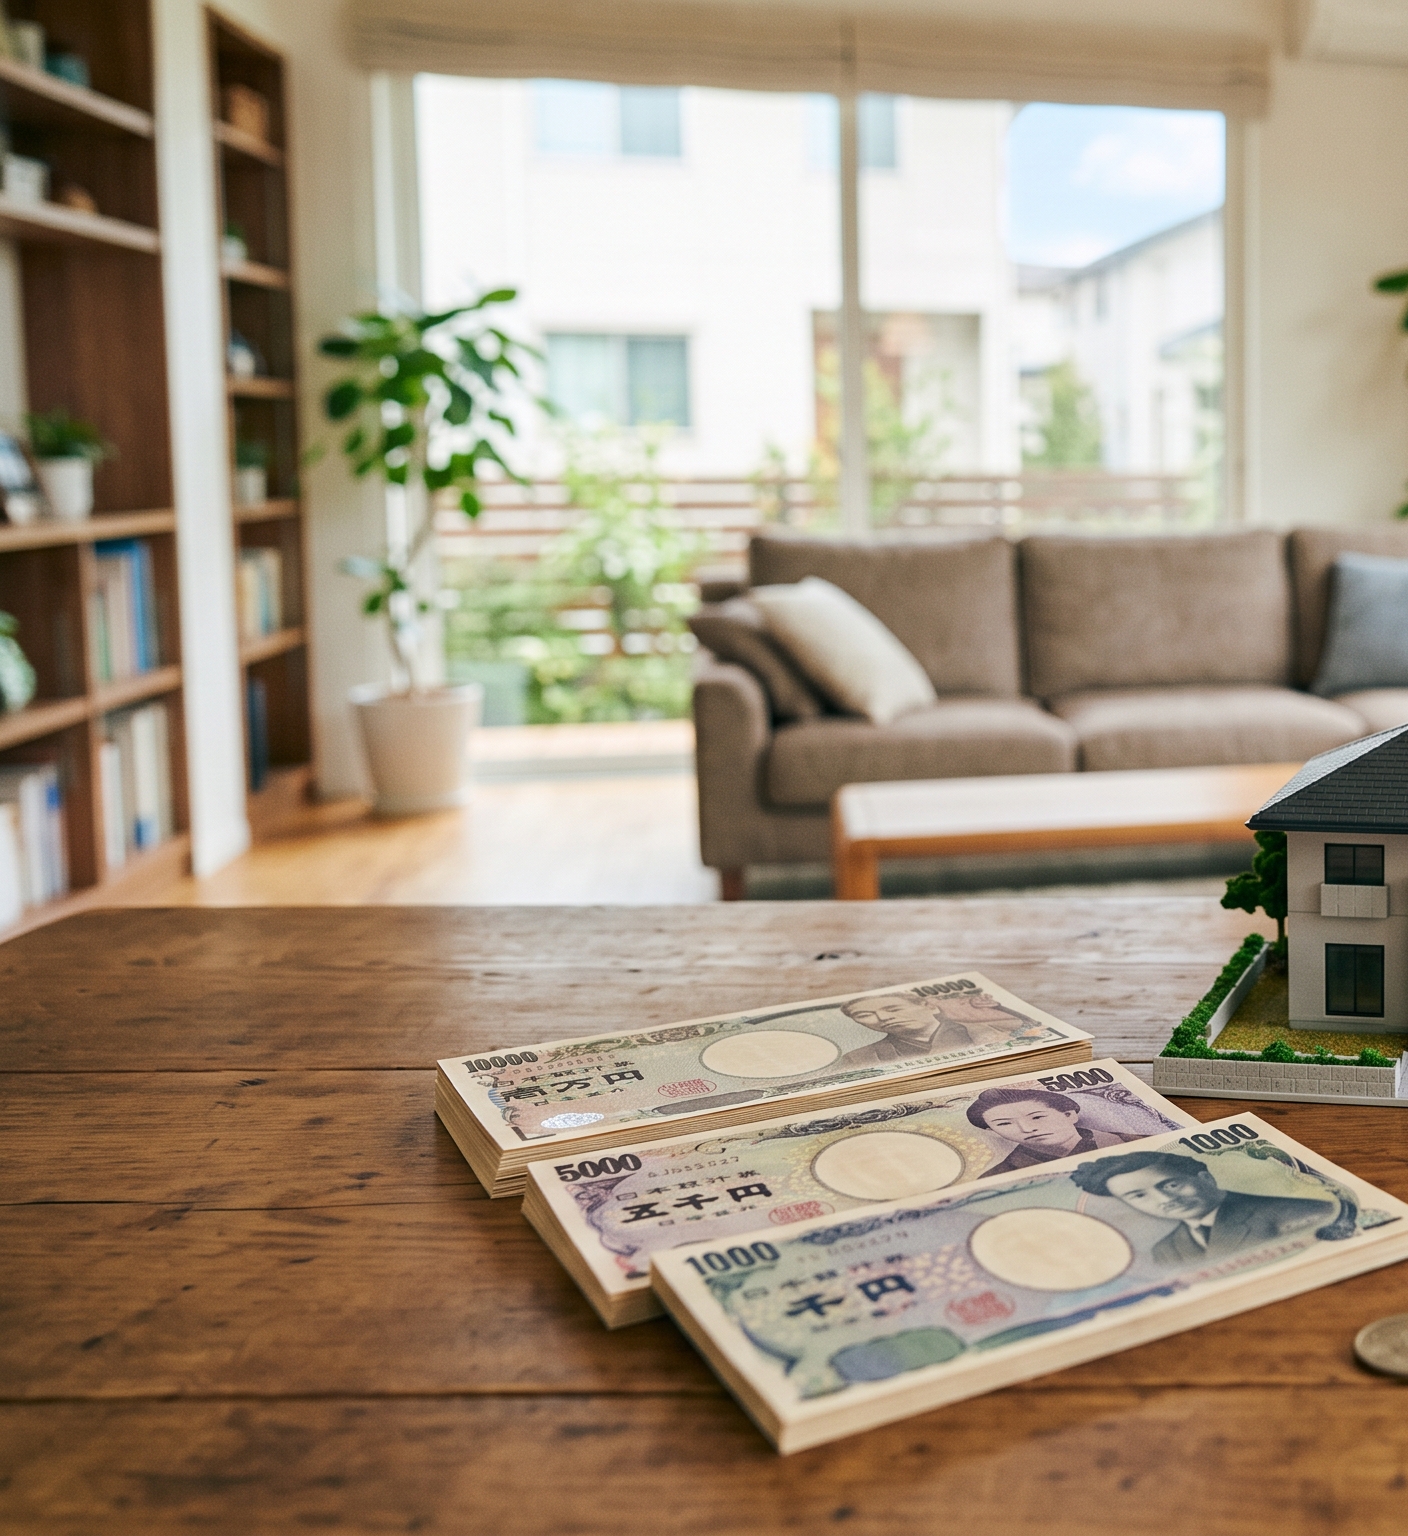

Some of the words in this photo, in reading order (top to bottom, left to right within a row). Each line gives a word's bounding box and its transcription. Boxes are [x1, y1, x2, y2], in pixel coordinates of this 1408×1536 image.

[910, 978, 977, 997] 10000
[462, 1051, 539, 1074] 10000
[1037, 1067, 1114, 1093] 5000
[1178, 1122, 1260, 1154] 1000
[554, 1153, 643, 1183] 5000
[620, 1182, 773, 1223] 五千円
[685, 1240, 780, 1276] 1000
[785, 1274, 916, 1317] 千円
